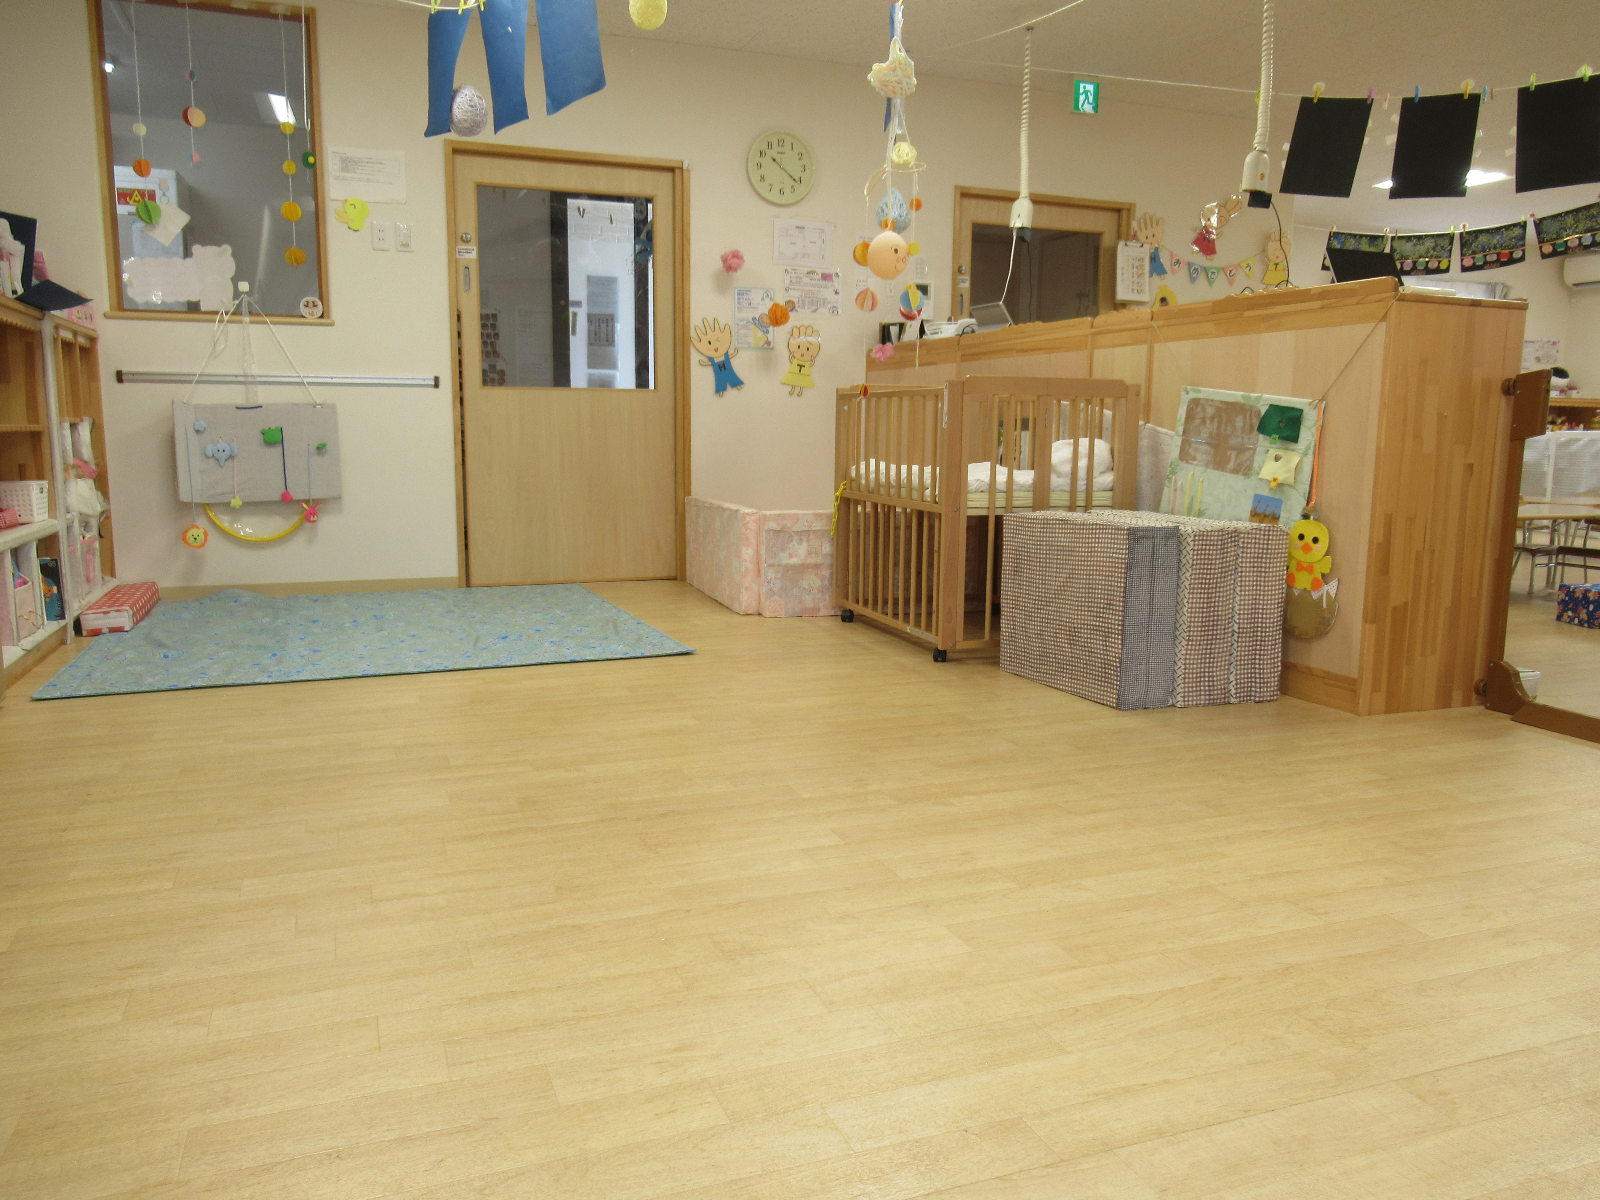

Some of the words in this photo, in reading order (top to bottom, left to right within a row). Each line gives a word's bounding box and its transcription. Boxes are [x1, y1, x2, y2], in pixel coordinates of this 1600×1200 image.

[767, 141, 772, 150] 11
[778, 138, 784, 148] 12
[790, 142, 794, 151] 1
[798, 152, 803, 161] 2
[756, 162, 762, 170] 9
[801, 164, 806, 173] 3
[760, 174, 765, 182] 8
[796, 176, 802, 184] 4
[768, 183, 773, 192] 7
[791, 185, 795, 194] 5
[1273, 262, 1279, 271] T
[718, 362, 727, 372] H
[797, 364, 805, 373] T
